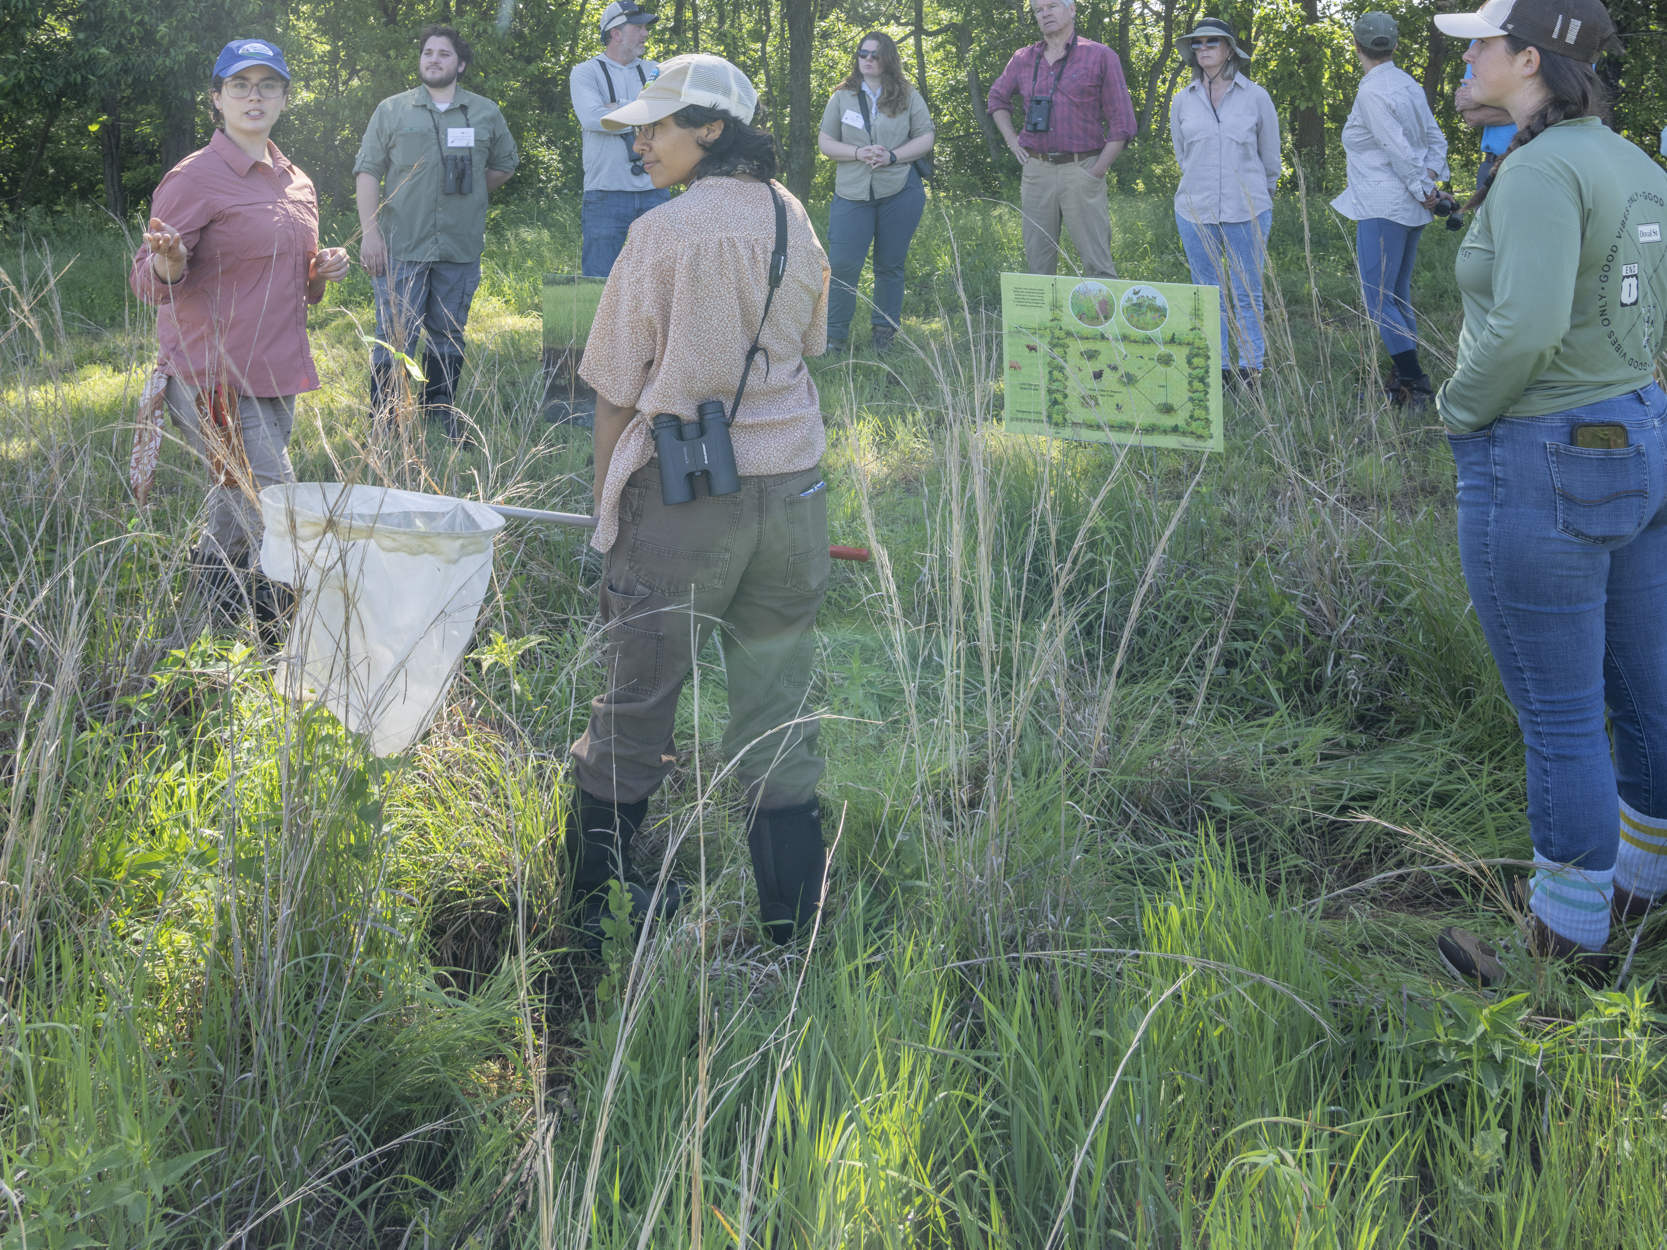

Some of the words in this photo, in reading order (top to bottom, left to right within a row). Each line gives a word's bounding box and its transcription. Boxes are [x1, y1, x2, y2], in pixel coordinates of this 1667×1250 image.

[1642, 191, 1664, 207] GOOD
[1599, 244, 1618, 284] GOOD
[1625, 266, 1636, 274] END
[1628, 282, 1632, 298] 1
[1598, 293, 1611, 327] ONLY
[1607, 330, 1627, 361] VIBES
[1628, 357, 1648, 371] GOOD
